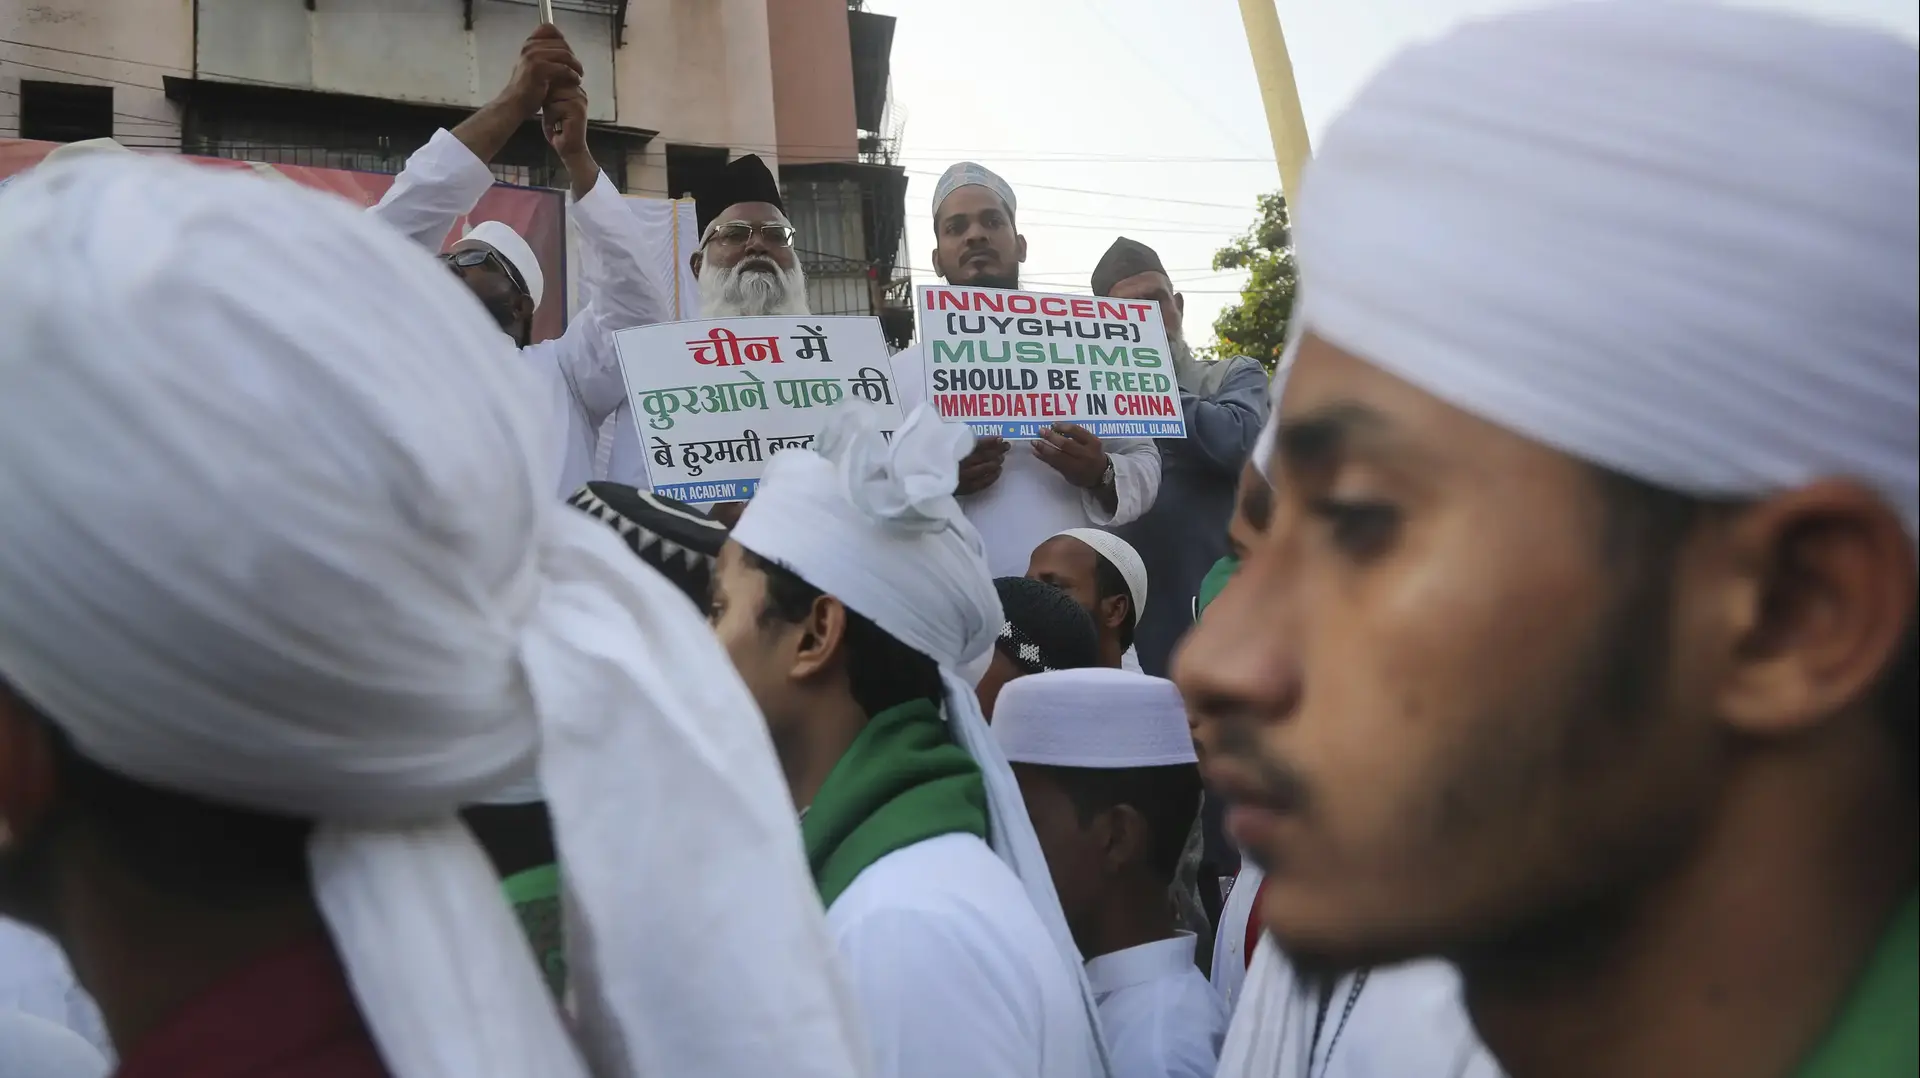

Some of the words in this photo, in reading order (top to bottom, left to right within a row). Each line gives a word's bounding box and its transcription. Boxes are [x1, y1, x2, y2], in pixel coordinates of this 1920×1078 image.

[926, 290, 1152, 322] INNOCENT
[946, 312, 1141, 343] (UYGHUR)
[685, 328, 785, 367] चीन
[790, 324, 832, 362] में
[932, 340, 1162, 368] MUSLIMS
[773, 378, 843, 408] पाक
[848, 367, 894, 405] की
[933, 368, 1038, 392] SHOULD
[1047, 369, 1081, 391] BE
[1090, 371, 1171, 393] FREED
[933, 393, 1078, 417] IMMEDIATELY
[1087, 394, 1108, 415] IN
[1114, 394, 1176, 416] CHINA
[1020, 424, 1036, 436] ALL
[1099, 423, 1148, 436] JAMIYATUL
[1150, 423, 1181, 435] ULAMA
[651, 436, 675, 468] बे
[679, 429, 763, 477] हुरमती
[690, 483, 736, 500] ACADEMY
